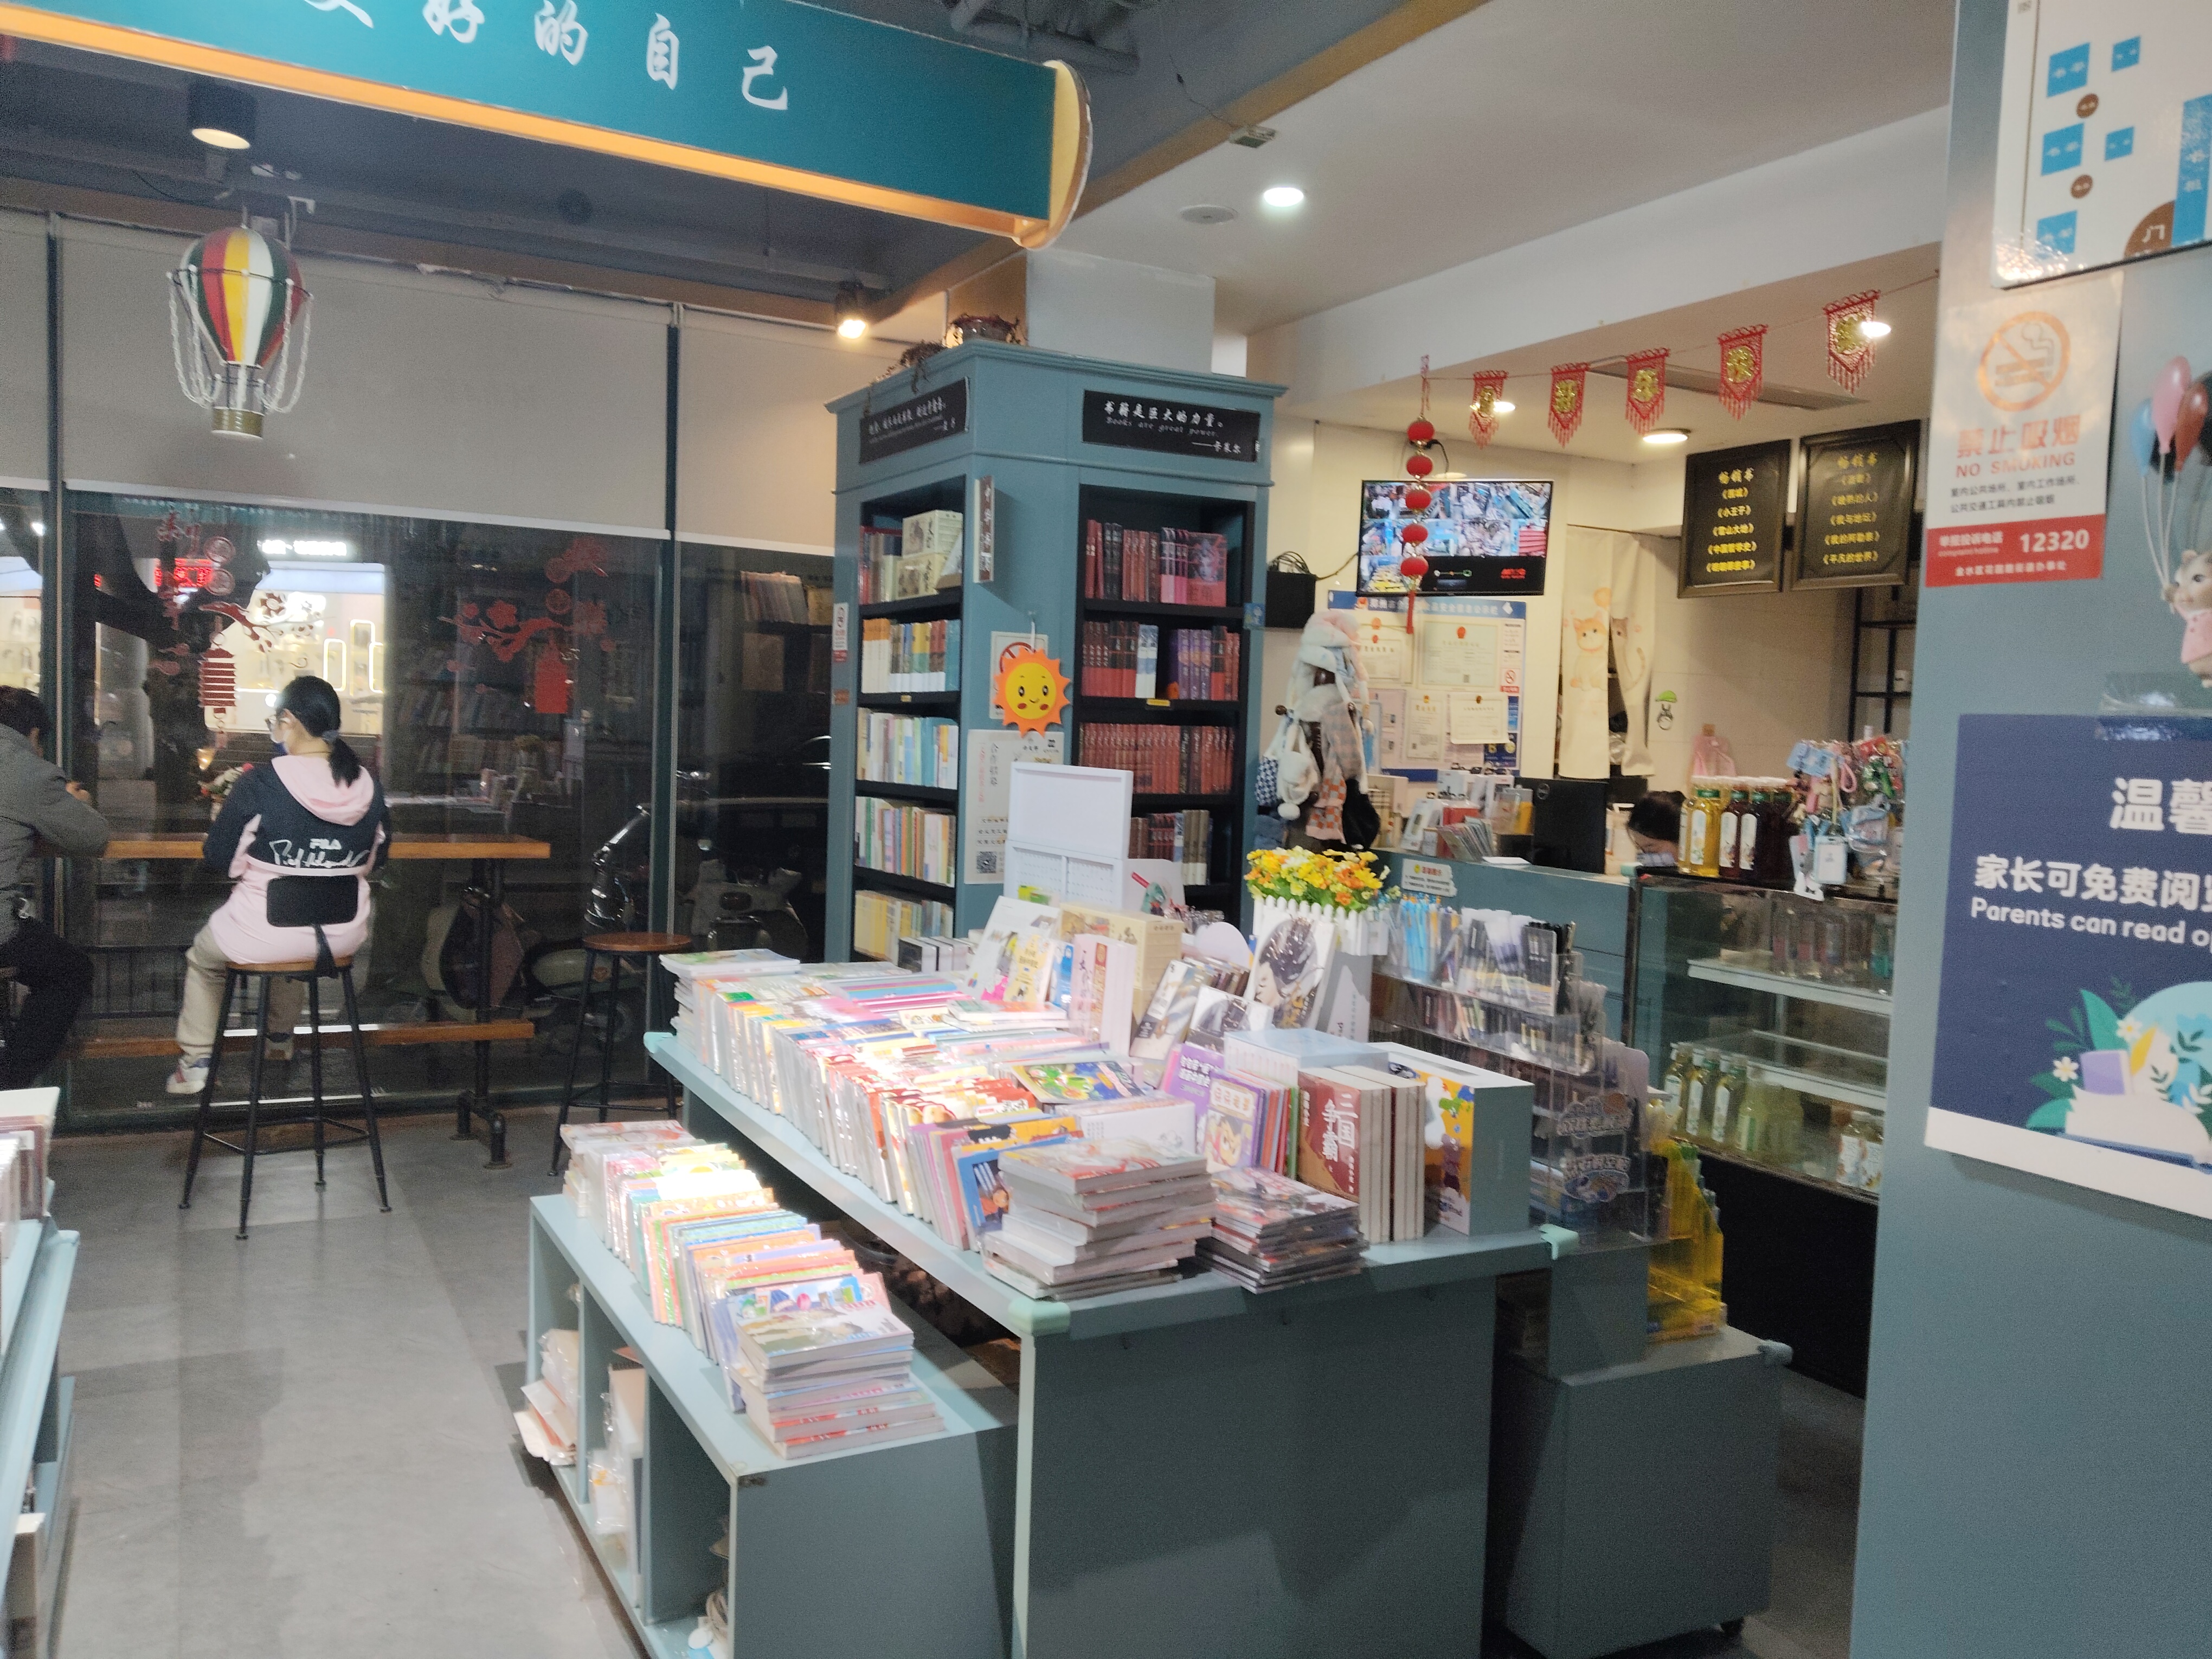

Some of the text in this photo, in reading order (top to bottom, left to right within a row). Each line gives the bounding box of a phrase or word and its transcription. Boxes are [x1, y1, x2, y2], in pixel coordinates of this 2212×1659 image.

[305, 0, 788, 110] 好的自己
[1158, 425, 1184, 433] great
[1957, 415, 2081, 459] 禁止吸烟
[1956, 452, 2075, 478] NO SMOKING
[2020, 529, 2090, 553] 12320
[2110, 777, 2212, 835] 温馨
[1974, 854, 2212, 914] 家长可免费阅
[1971, 897, 2212, 953] Parents can read o
